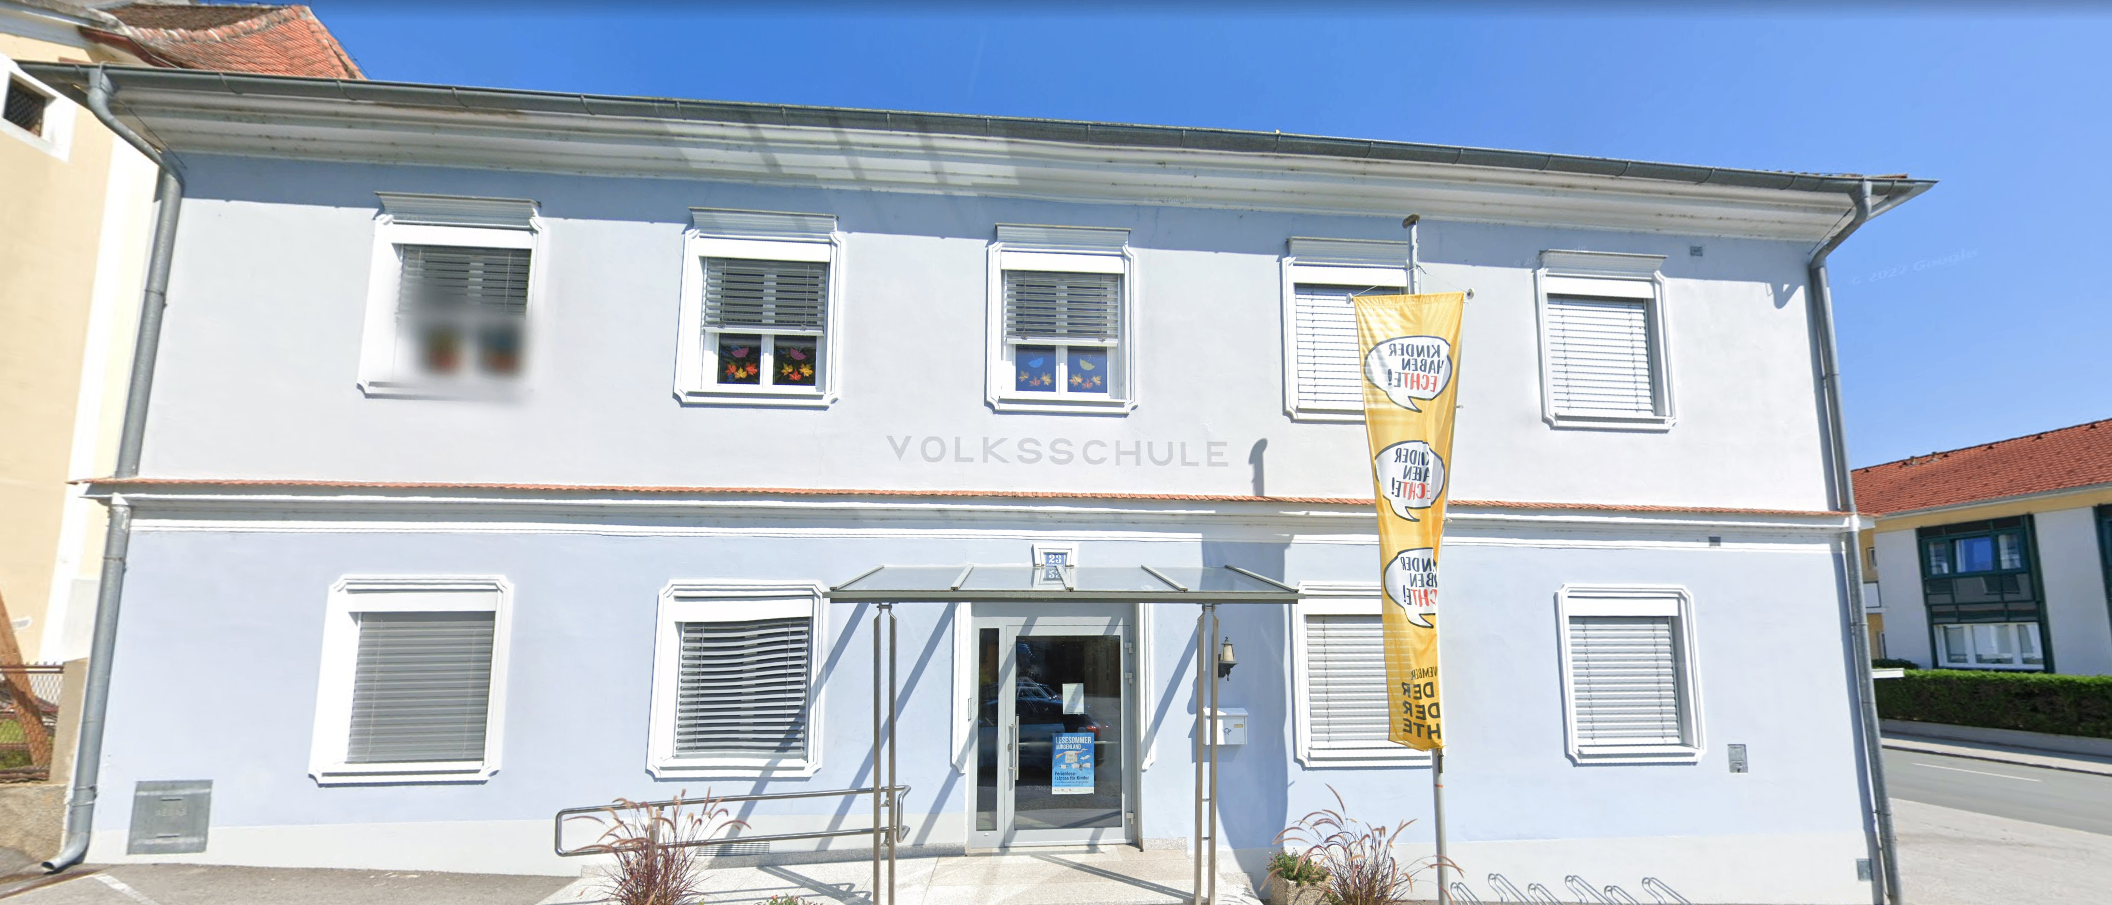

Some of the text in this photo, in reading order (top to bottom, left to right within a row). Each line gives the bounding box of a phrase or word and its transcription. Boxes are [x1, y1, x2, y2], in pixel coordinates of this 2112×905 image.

[887, 435, 1229, 468] VOLKSSCHULE
[1048, 554, 1061, 563] 23
[1055, 736, 1092, 744] LESESOMMER
